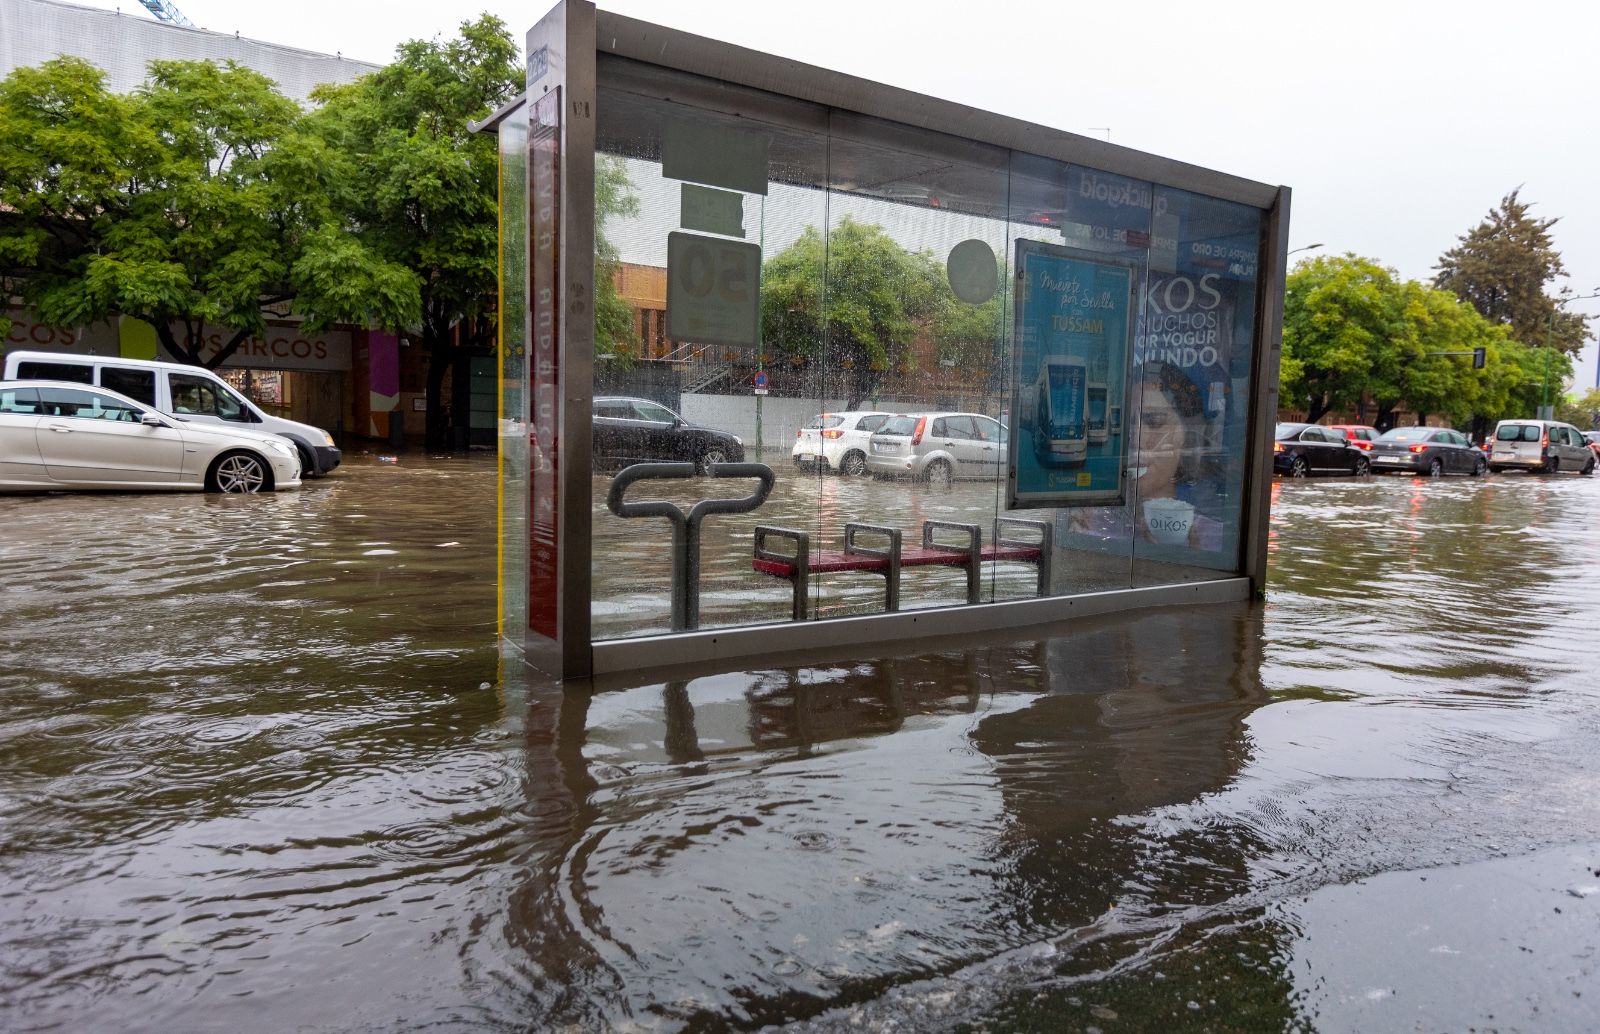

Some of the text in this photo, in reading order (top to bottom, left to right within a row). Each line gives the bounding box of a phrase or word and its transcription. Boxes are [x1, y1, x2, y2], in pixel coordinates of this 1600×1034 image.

[539, 161, 552, 250] AVDA
[1060, 293, 1078, 310] por
[1138, 273, 1221, 315] KOS
[1051, 314, 1104, 334] TUSSAM
[1137, 310, 1216, 333] MUCHOS
[6, 321, 75, 346] COS
[1162, 329, 1216, 346] YOGUR
[183, 333, 328, 360] OS ARCOS
[1133, 346, 1218, 367] MUNDO
[1150, 517, 1187, 532] OIKOS
